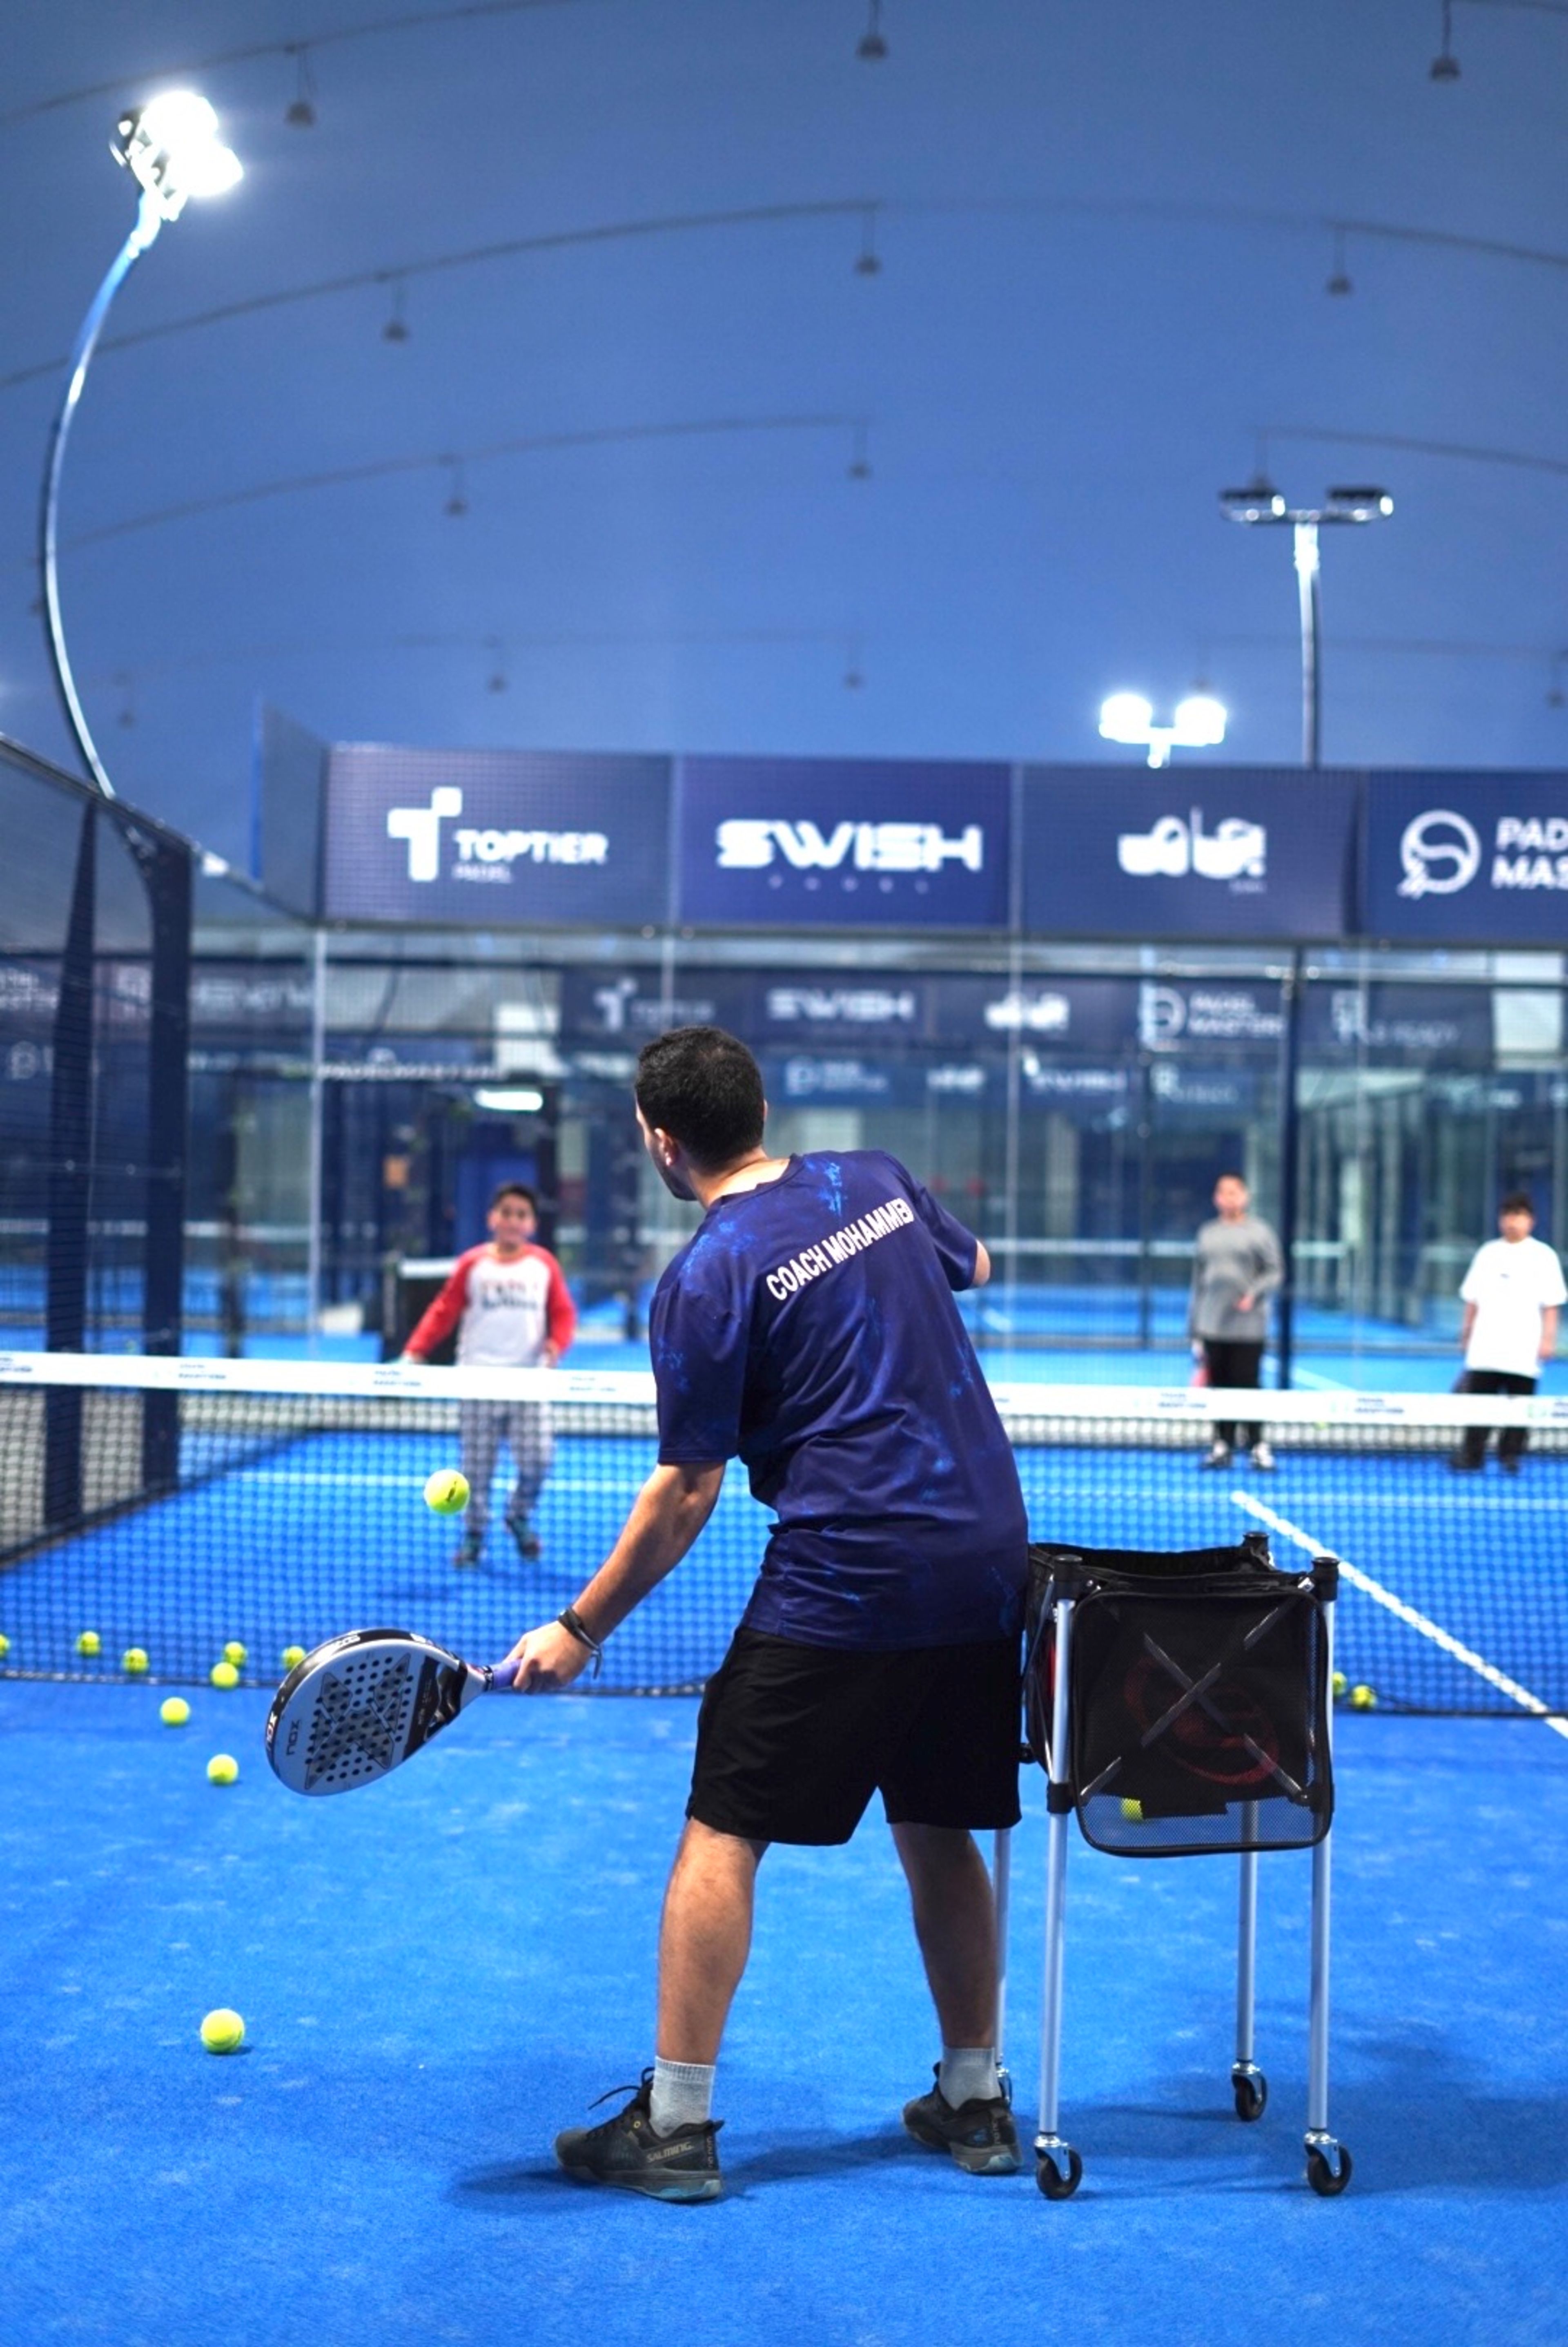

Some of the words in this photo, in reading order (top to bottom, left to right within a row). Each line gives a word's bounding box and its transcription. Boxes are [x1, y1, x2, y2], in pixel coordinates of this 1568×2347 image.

[453, 829, 609, 865] TOPTIER
[717, 819, 982, 871] SWISH
[766, 1244, 833, 1301] COACH
